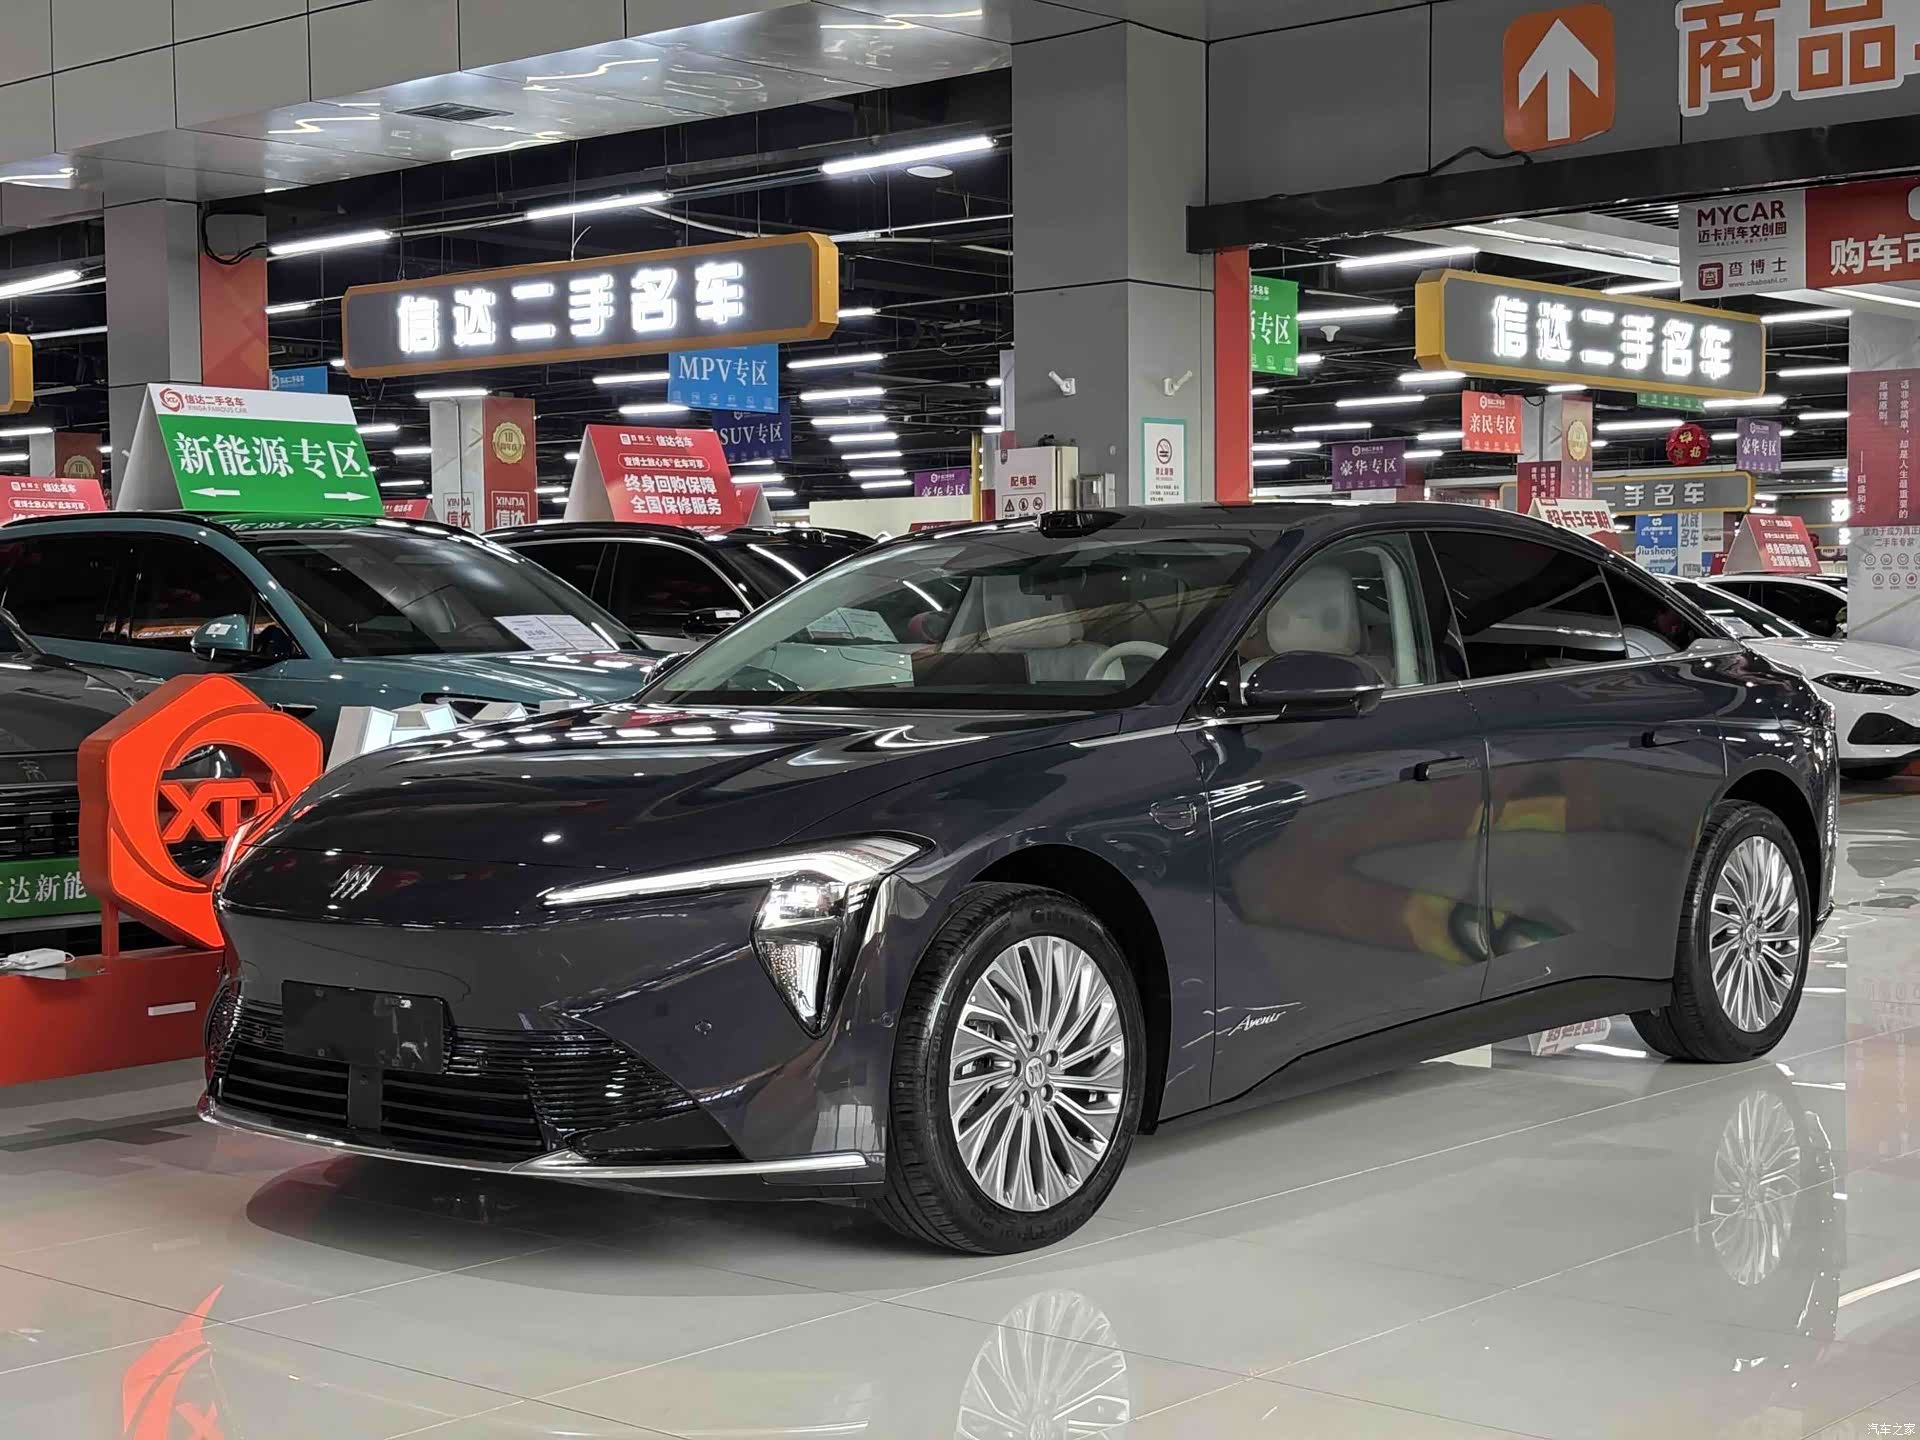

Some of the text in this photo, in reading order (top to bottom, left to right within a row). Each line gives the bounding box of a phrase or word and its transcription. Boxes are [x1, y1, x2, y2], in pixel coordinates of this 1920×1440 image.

[1678, 0, 1920, 113] 商品
[1697, 201, 1786, 227] MYCAR
[1698, 221, 1787, 243] 迈卡汽车文创园
[1728, 257, 1787, 277] 查博士
[397, 263, 744, 353] 信达二手名车
[1250, 310, 1291, 344] 专区
[1491, 295, 1732, 379] 信达二手名车
[678, 355, 768, 386] MPV专区
[185, 394, 245, 407] 信达二手名车
[720, 422, 783, 445] SUV专区
[1470, 413, 1516, 434] 亲民专区
[174, 432, 368, 480] 新能源专区
[1340, 457, 1396, 476] 豪华专区
[624, 474, 718, 494] 终身回购保障
[1010, 475, 1037, 487] 配电箱
[447, 497, 471, 506] XINDA
[496, 496, 525, 506] XINDA
[630, 495, 722, 515] 全国保修服务
[1637, 545, 1677, 557] Jiusheng
[0, 871, 87, 903] 达新能
